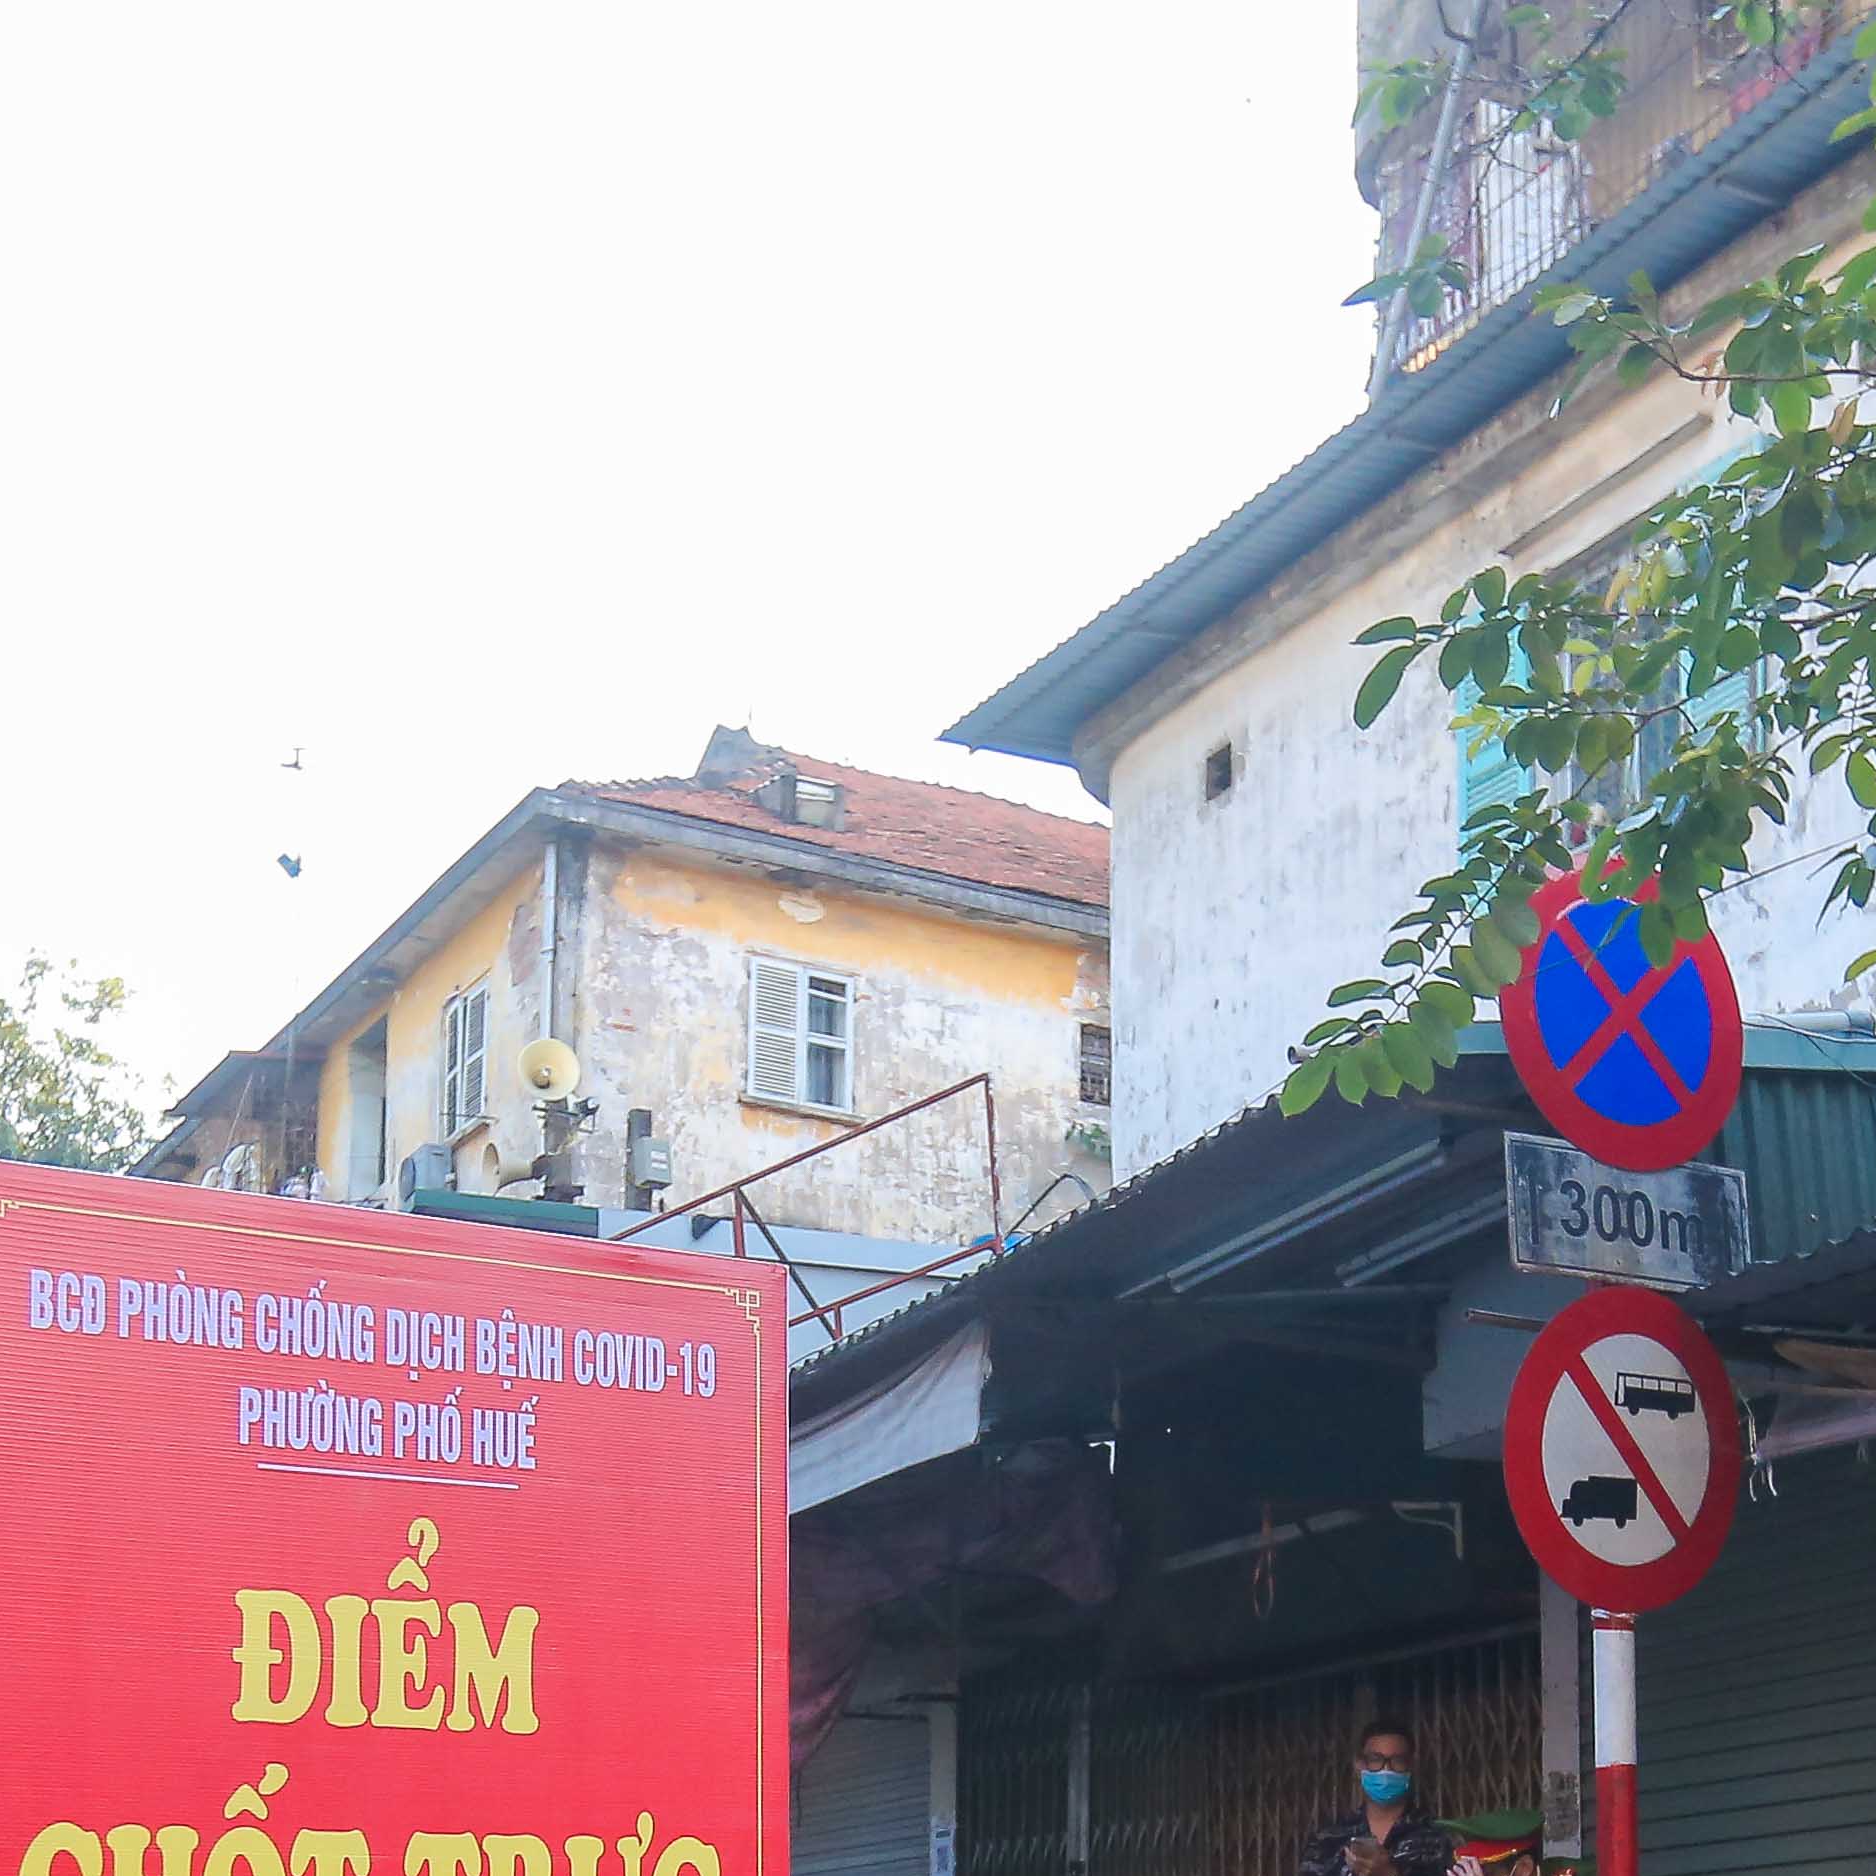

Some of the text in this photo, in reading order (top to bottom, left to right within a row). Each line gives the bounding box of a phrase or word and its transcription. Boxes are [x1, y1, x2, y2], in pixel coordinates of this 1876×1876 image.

[1559, 1179, 1701, 1252] 300m
[29, 1268, 717, 1398] BCĐ PHÒNG CHỐNG DỊCH BỆNH COVID-19
[238, 1379, 540, 1471] PHƯỜNG PHỐ HUẾ
[230, 1516, 541, 1735] ĐIỂM
